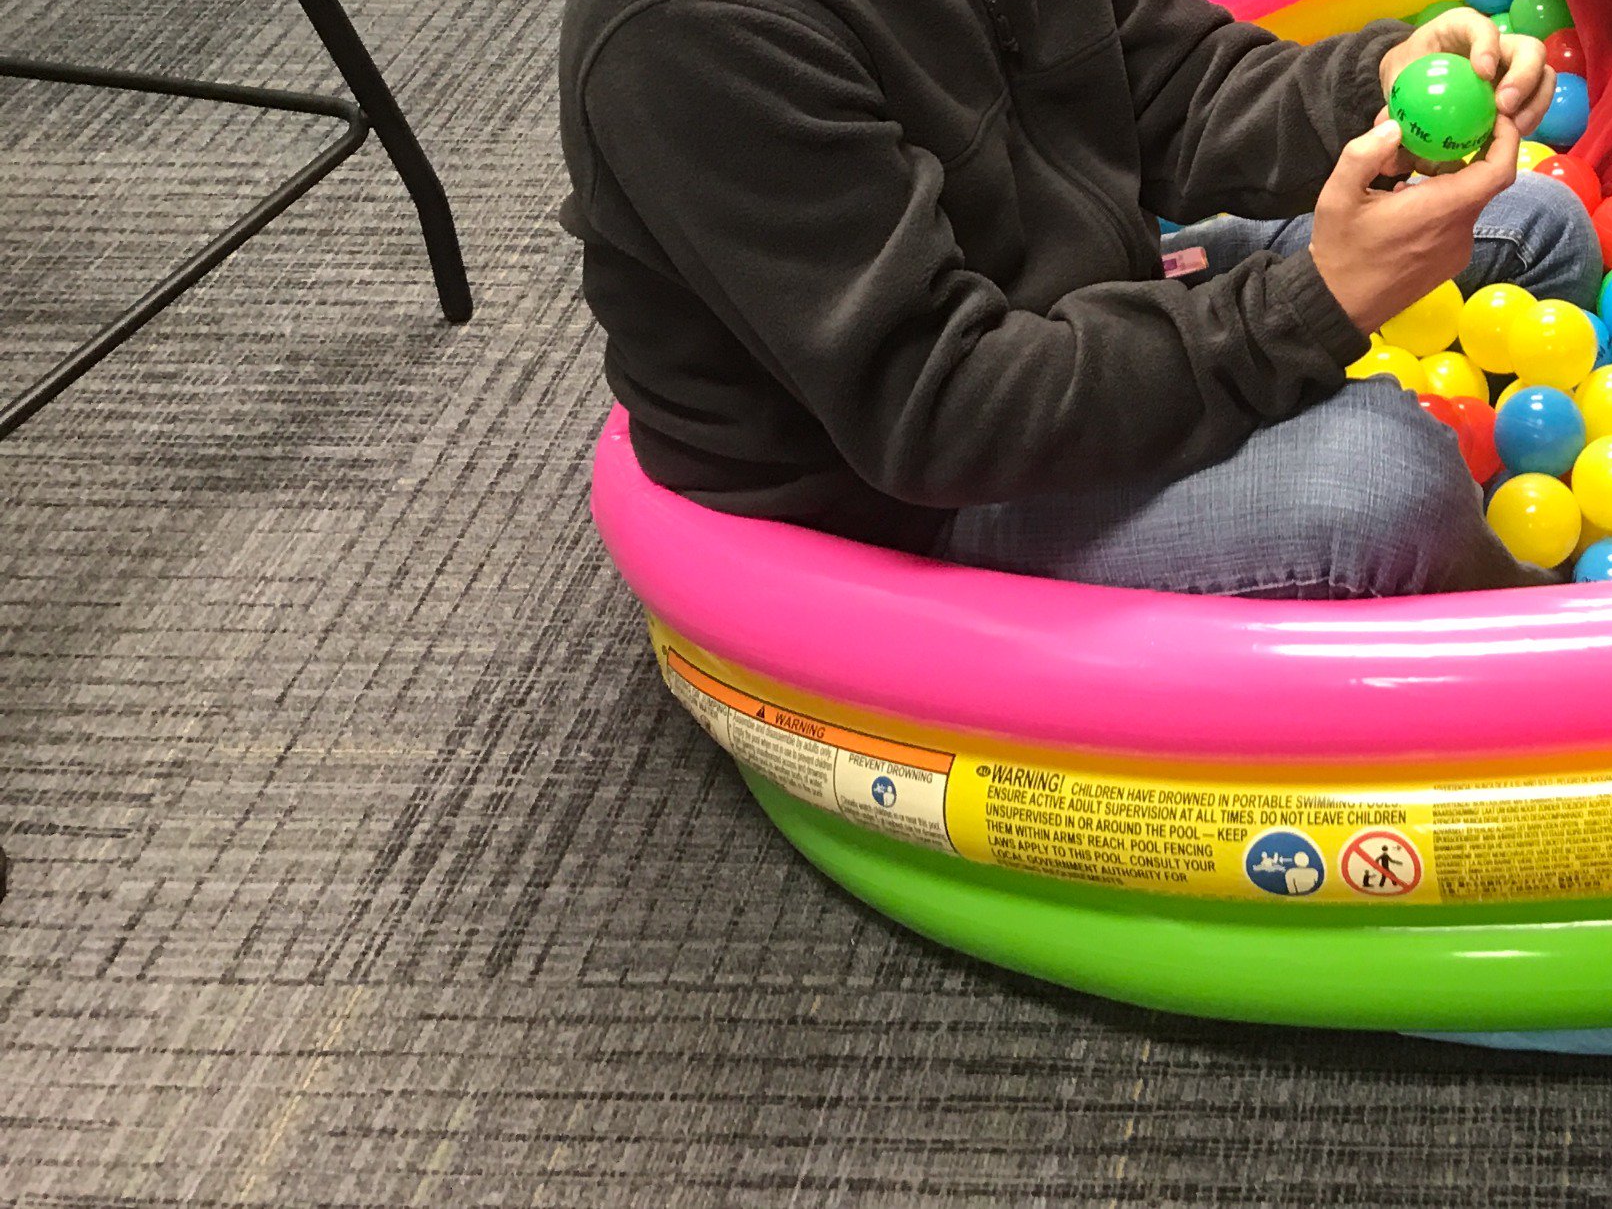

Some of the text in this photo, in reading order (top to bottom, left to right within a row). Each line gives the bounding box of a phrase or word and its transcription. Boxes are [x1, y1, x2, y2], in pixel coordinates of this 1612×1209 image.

[775, 711, 826, 739] WARNING
[848, 753, 933, 784] PREVENT DROWNING
[991, 764, 1065, 793] WARNING!
[1071, 782, 1124, 801] CHILDREN
[1127, 786, 1156, 803] HAVE
[1158, 789, 1216, 807] DROWNED
[1218, 793, 1230, 808] IN
[1232, 793, 1292, 809] PORTABLE
[985, 802, 1248, 842] UNSUPERVISED IN OR AROUND THE POOL KEEP
[987, 784, 1407, 826] ENSURE ACTIVE ADULT SUPERVISION AT ALL TIMES. DO NOT LEAVE CHILDREN
[985, 818, 1213, 858] THEM WITHIN ARMS' REACH. POOL FENCING
[987, 835, 1015, 850] LAWS
[1018, 840, 1049, 856] APPLY
[1051, 845, 1066, 858] TO
[1068, 847, 1092, 861] THIS
[1129, 855, 1181, 871] CONSULT
[1183, 858, 1217, 873] YOUR
[990, 848, 1023, 863] LOCAL
[1026, 853, 1098, 875] GOVERNMENT
[1100, 865, 1162, 882] AUTHORITY
[1164, 870, 1189, 883] FOR
